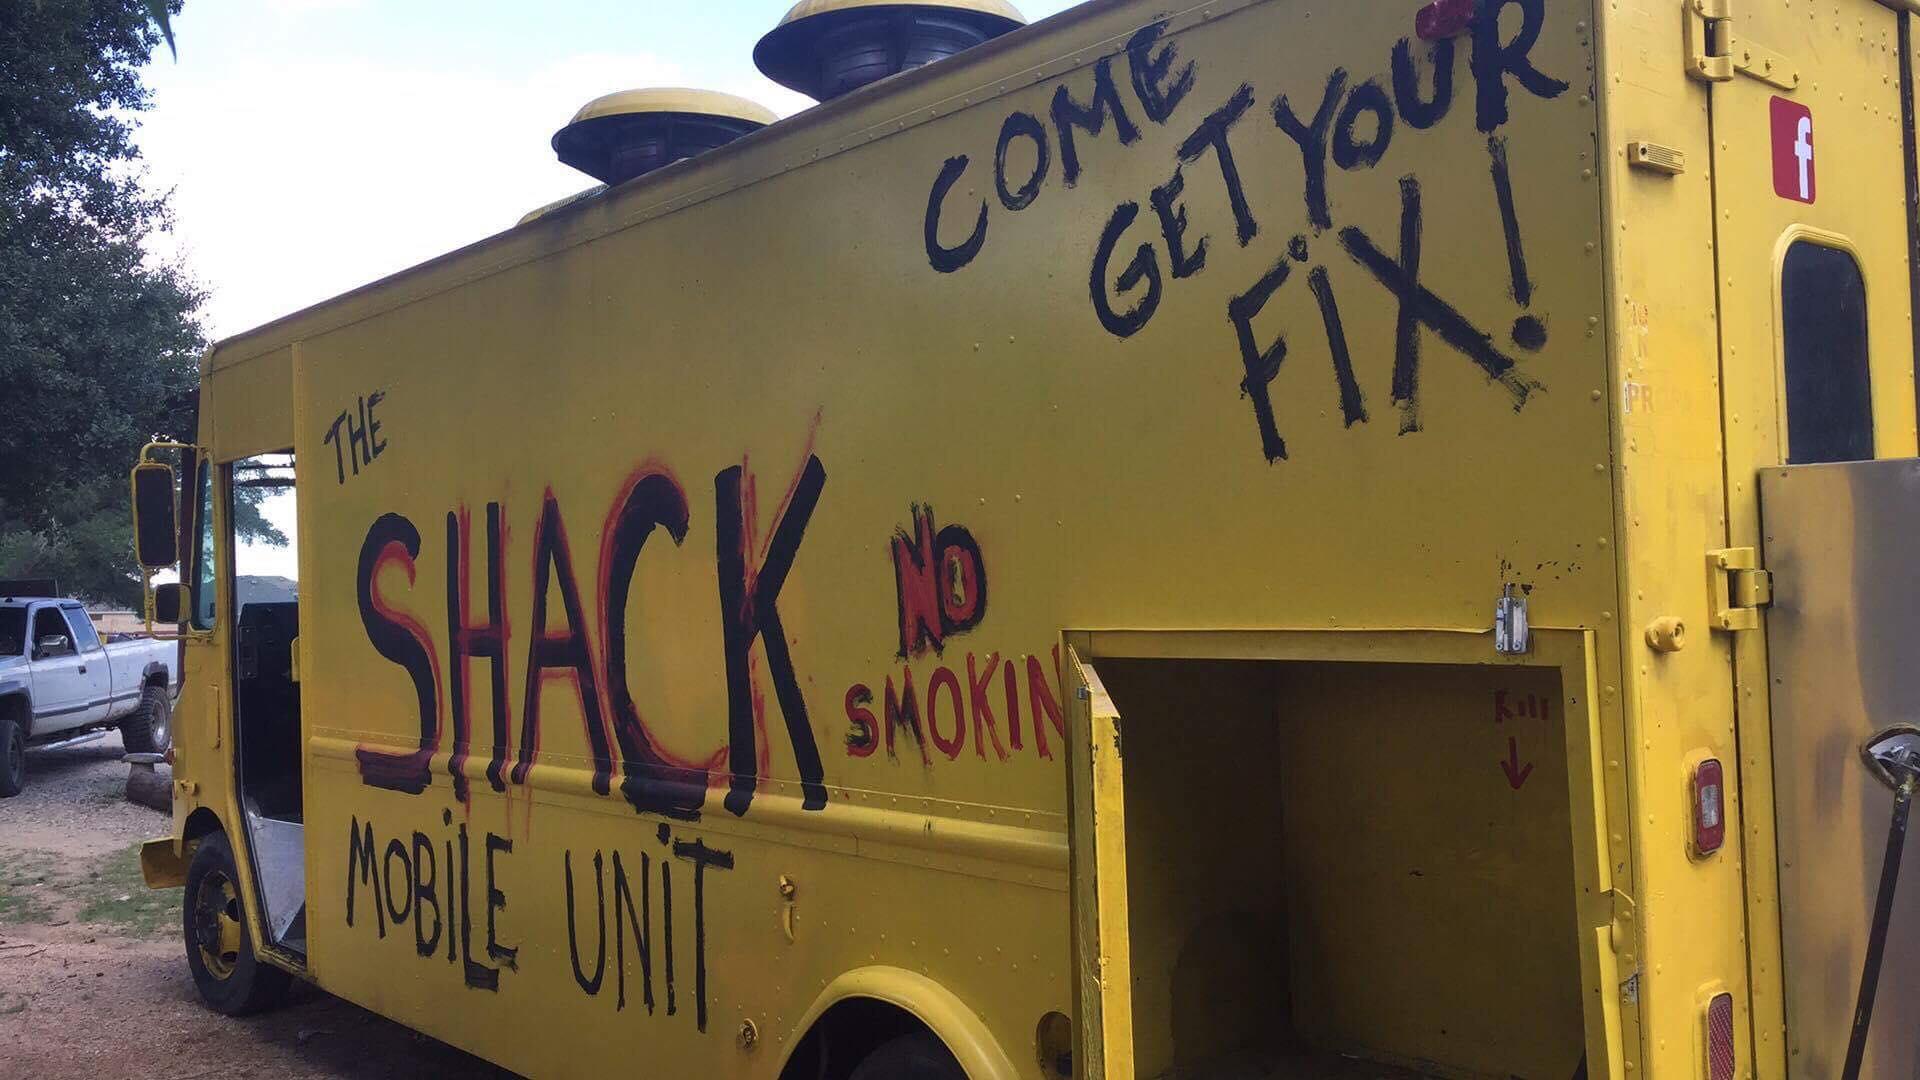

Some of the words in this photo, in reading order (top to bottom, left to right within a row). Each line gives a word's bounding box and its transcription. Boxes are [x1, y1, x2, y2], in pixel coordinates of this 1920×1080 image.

[924, 14, 1196, 273] COME
[1089, 83, 1257, 341] GET
[1271, 0, 1570, 237] YOUR
[323, 391, 387, 484] THE
[355, 438, 828, 823] SHACK
[890, 502, 988, 664] NO
[845, 644, 1064, 767] SMOKIN
